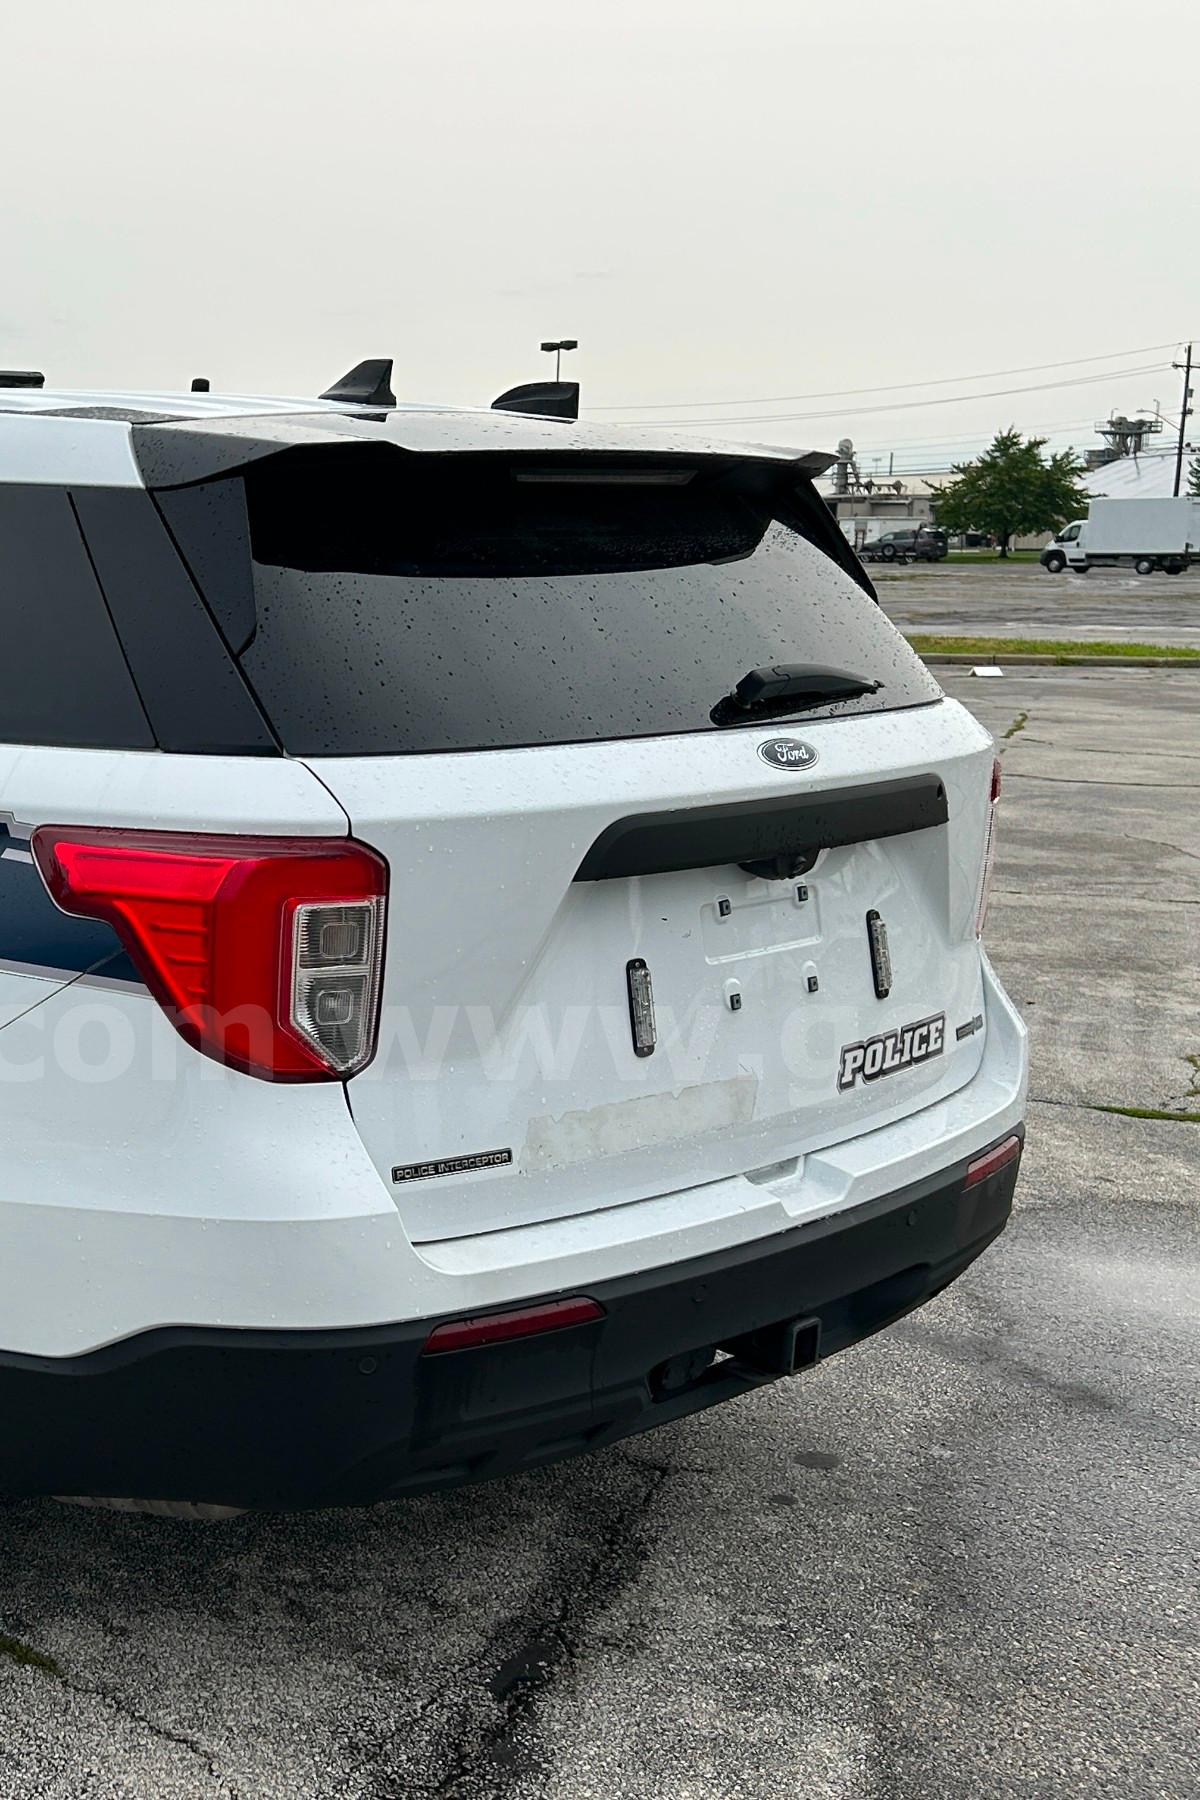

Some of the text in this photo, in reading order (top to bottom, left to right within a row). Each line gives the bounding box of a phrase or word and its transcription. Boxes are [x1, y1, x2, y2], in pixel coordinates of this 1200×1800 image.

[774, 743, 809, 762] Ford
[839, 1017, 945, 1086] POLICE
[396, 1152, 509, 1180] POLICE INTERCEPTOR
